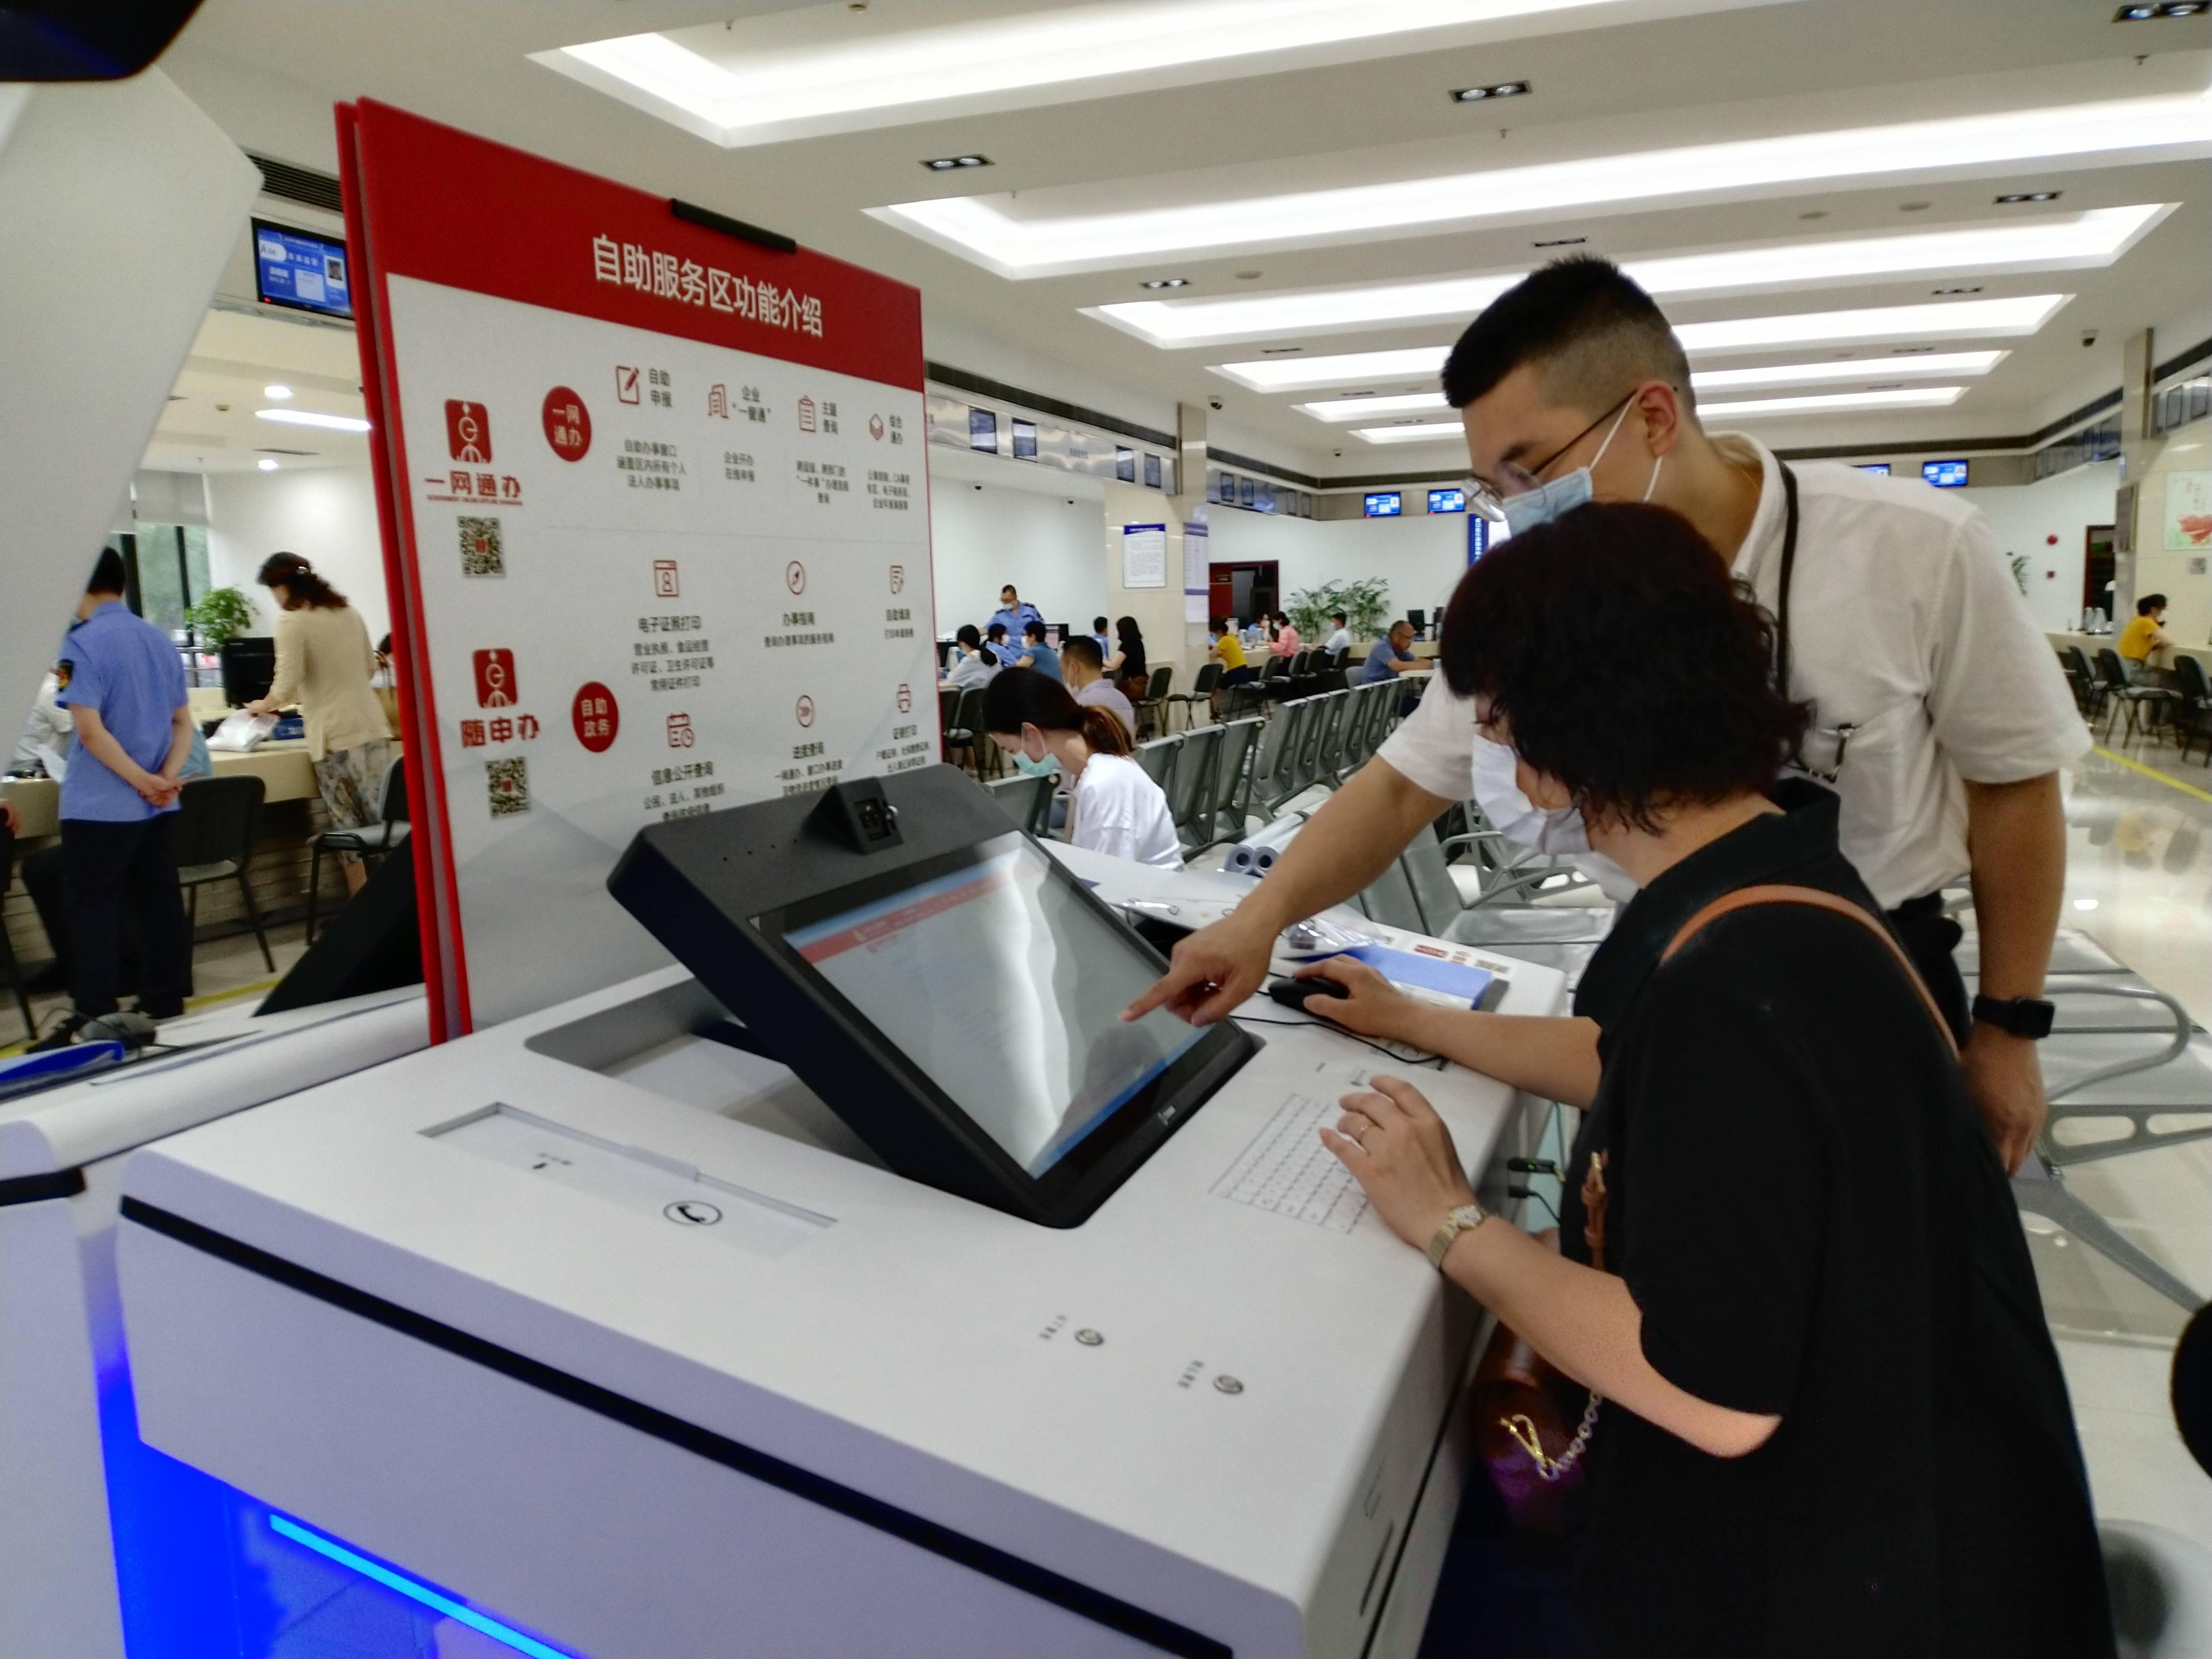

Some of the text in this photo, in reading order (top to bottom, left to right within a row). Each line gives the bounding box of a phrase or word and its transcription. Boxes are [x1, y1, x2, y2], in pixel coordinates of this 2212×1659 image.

[593, 233, 823, 337] 自助服务区功能介绍
[649, 367, 670, 386] 自助
[650, 389, 672, 408] 申报
[741, 385, 760, 403] 企业
[552, 404, 580, 425] 一网
[554, 425, 582, 446] 通办
[424, 469, 521, 498] 一网通办
[638, 615, 701, 633] 电子证照打印
[782, 612, 815, 626] 办事指南
[580, 697, 608, 718] 自助
[460, 713, 540, 748] 随申办
[793, 742, 824, 759] 进度查询
[651, 761, 713, 786] 信息公开查询
